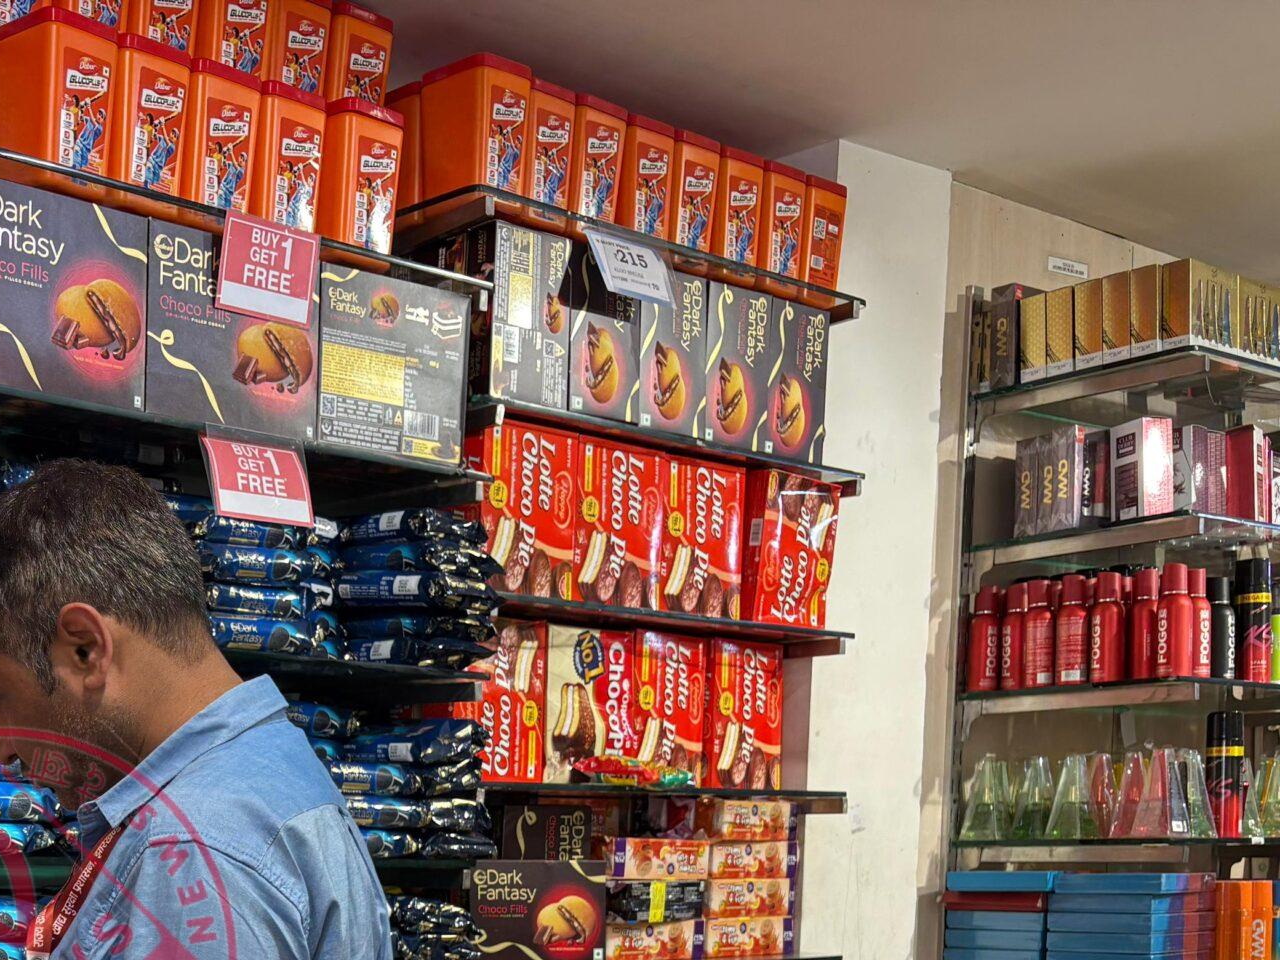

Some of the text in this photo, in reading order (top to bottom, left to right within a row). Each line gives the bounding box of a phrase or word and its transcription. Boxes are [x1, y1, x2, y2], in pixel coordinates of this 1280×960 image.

[251, 229, 279, 249] BUY
[249, 237, 292, 271] GET 1
[22, 262, 49, 283] Fills
[243, 263, 292, 295] FREE
[231, 443, 261, 457] BUY
[238, 451, 280, 476] GET 1
[538, 435, 556, 511] Lotte
[236, 472, 288, 497] FREE
[628, 454, 644, 525] Lotte
[518, 432, 538, 568] Choco Pie
[610, 450, 627, 579] Choco Pie
[487, 870, 522, 886] Dark
[478, 886, 536, 903] Fantasy
[478, 905, 528, 915] Choco Fills
